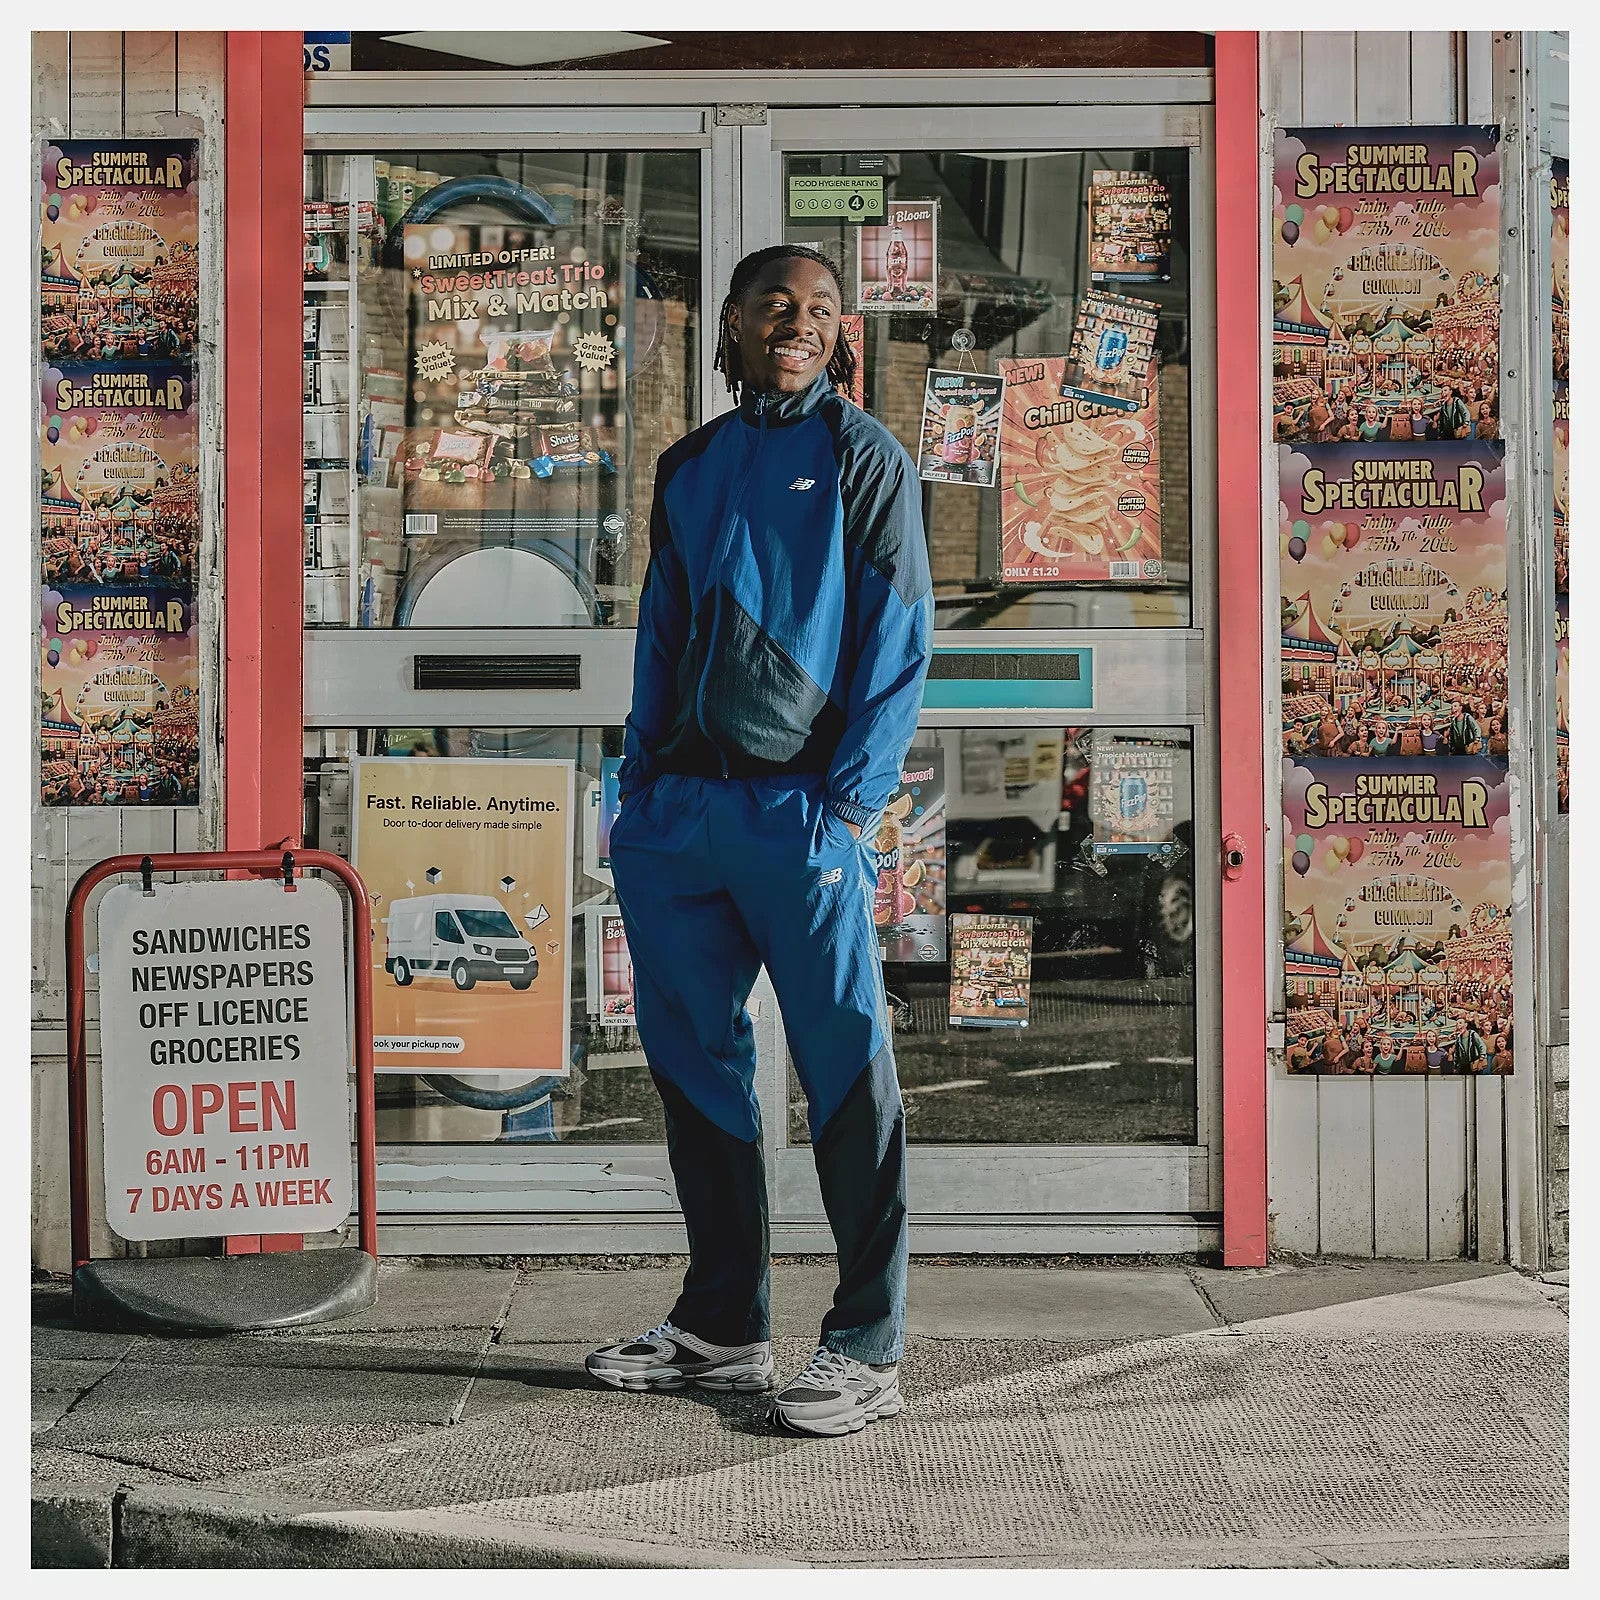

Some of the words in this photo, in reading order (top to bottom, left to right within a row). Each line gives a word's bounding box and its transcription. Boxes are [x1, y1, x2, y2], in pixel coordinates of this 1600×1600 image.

[92, 151, 148, 167] SUMMER
[1348, 145, 1427, 164] SUMMER
[56, 156, 183, 189] SPECTACULAR
[1296, 151, 1478, 198] SPECTACULAR
[1149, 184, 1165, 192] Trio
[1101, 195, 1120, 205] Mix
[1122, 195, 1130, 204] &
[1133, 193, 1166, 203] Match
[896, 210, 931, 222] Bloom
[429, 250, 493, 270] LIMITED
[498, 246, 556, 264] OFFER!
[420, 267, 556, 294] SweetTreat
[560, 261, 605, 282] Trio
[1363, 278, 1421, 294] COMMON
[428, 295, 479, 321] Mix
[487, 294, 509, 317] &
[516, 286, 608, 315] Match
[1086, 291, 1105, 301] NEW!
[1086, 298, 1114, 312] Tropical
[1114, 304, 1136, 316] Splash
[1136, 309, 1158, 320] Flavor
[579, 350, 609, 362] Value!
[581, 342, 607, 353] Great
[421, 350, 447, 364] Great
[422, 361, 452, 373] Value!
[1005, 363, 1045, 387] NEW!
[92, 373, 149, 388] SUMMER
[935, 376, 964, 388] NEW!
[56, 378, 183, 411] SPECTACULAR
[1024, 400, 1072, 430] Chili
[550, 433, 579, 447] Shortie
[1123, 456, 1148, 464] EDITION
[1124, 449, 1149, 457] LIMITED
[1353, 459, 1434, 481] SUMMER
[1302, 465, 1485, 515] SPECTACULAR
[1005, 568, 1030, 577] ONLY
[1032, 567, 1060, 576] £1.20
[92, 596, 149, 611] SUMMER
[1371, 594, 1428, 610] COMMON
[56, 601, 184, 634] SPECTACULAR
[901, 768, 934, 783] lavor!
[1356, 774, 1437, 795] SUMMER
[367, 795, 406, 809] Fast.
[412, 796, 481, 811] Reliable.
[487, 797, 560, 814] Anytime.
[1305, 780, 1489, 829] SPECTACULAR
[383, 819, 405, 827] Door
[408, 820, 442, 828] to-door
[445, 820, 481, 831] delivery
[484, 821, 509, 829] made
[512, 822, 542, 831] simple
[1375, 910, 1433, 925] COMMON
[132, 924, 311, 955] SANDWICHES
[960, 940, 979, 948] Mix
[992, 939, 1025, 947] Match
[132, 960, 314, 992] NEWSPAPERS
[139, 1002, 189, 1029] OFF
[197, 998, 309, 1027] LICENCE
[150, 1034, 300, 1066] GROCERIES
[391, 1041, 410, 1050] your
[412, 1040, 440, 1050] pickup
[441, 1041, 460, 1049] now
[152, 1080, 297, 1136] OPEN
[146, 1147, 206, 1176] 6AM
[236, 1143, 309, 1170] 11PM
[126, 1188, 142, 1213] 7
[152, 1184, 223, 1212] DAYS
[230, 1183, 250, 1208] A
[255, 1178, 333, 1206] WEEK
